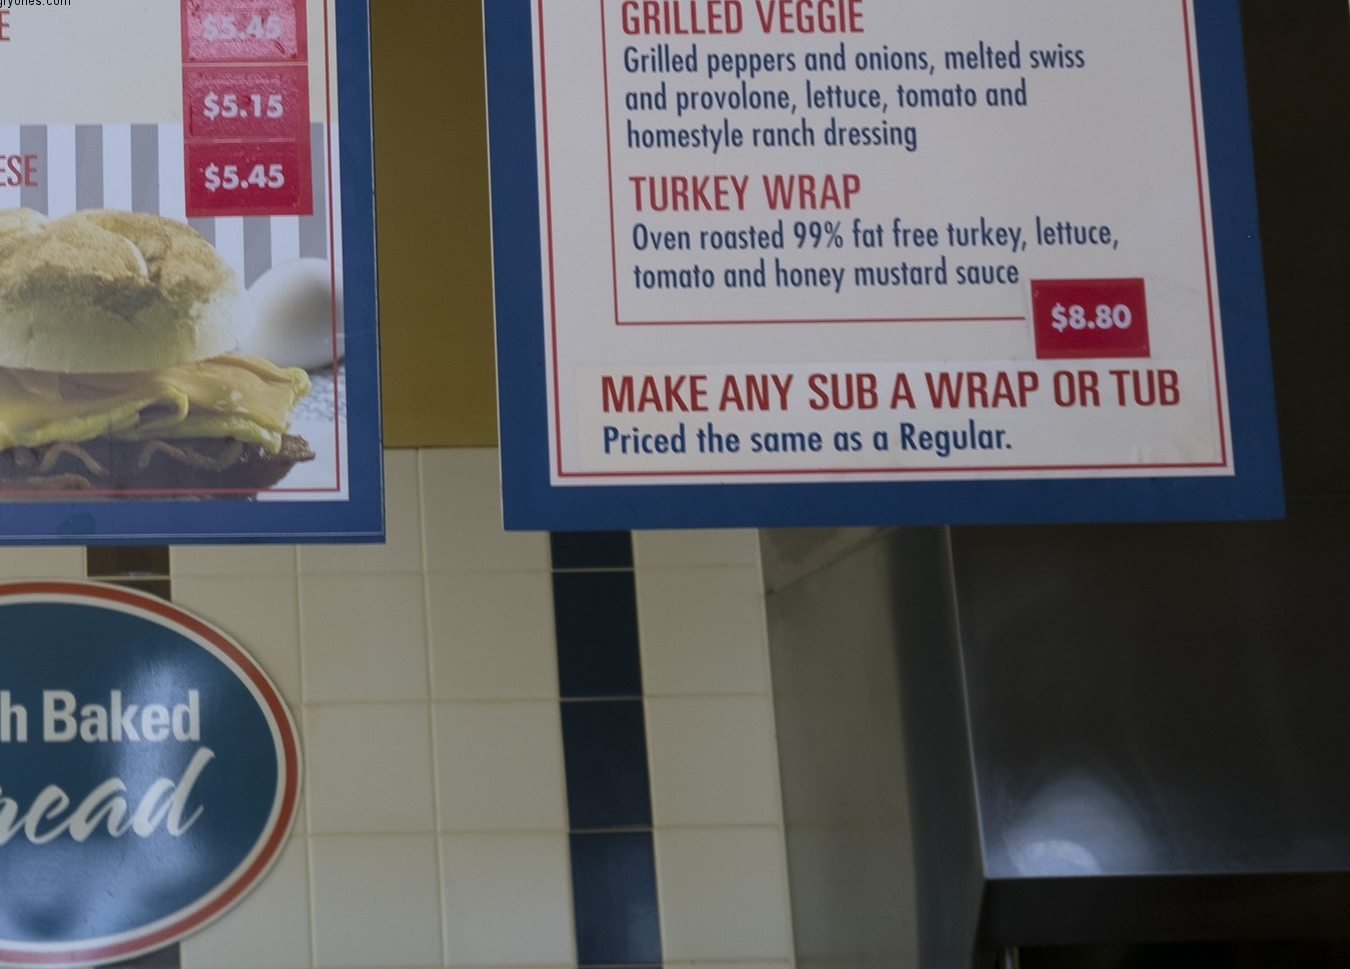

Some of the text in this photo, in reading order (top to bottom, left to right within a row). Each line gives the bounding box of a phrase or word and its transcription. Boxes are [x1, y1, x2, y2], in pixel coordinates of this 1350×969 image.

[621, 0, 743, 35] GRILLED
[203, 90, 284, 121] $5.15
[204, 162, 285, 193] $5.45
[628, 173, 861, 212] TURKEY WRAP
[633, 255, 1019, 294] tomato and honey mustard sauce
[1051, 302, 1132, 333] $8.80
[601, 369, 1181, 413] MAKE ANY SUB A WRAP OR TUB
[603, 418, 1012, 458] Priced the same as a Regular.
[43, 686, 200, 745] Baked
